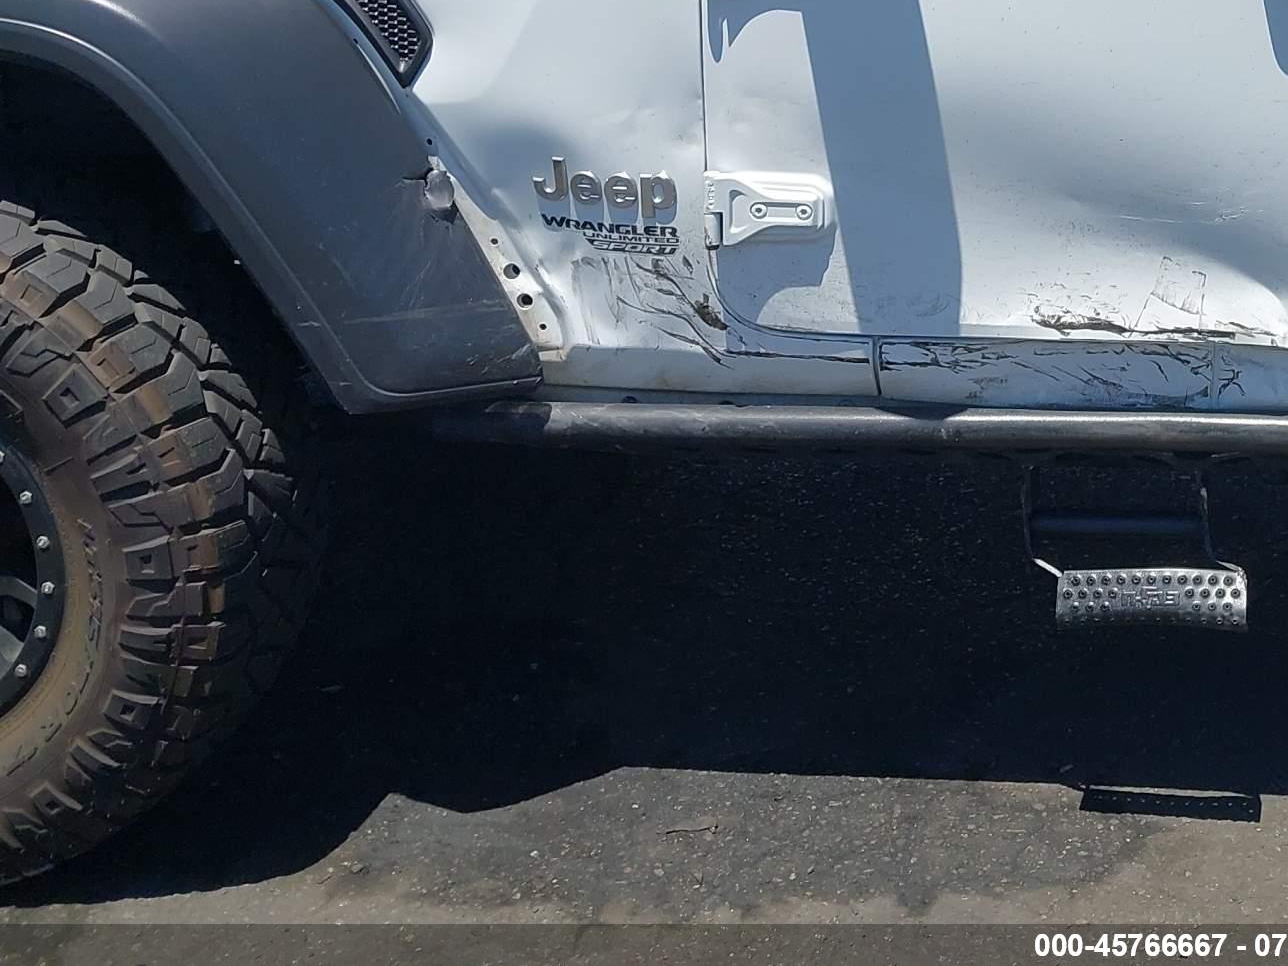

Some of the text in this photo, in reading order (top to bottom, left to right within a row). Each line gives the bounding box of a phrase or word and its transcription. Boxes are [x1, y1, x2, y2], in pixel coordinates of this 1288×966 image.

[532, 156, 678, 219] Jeep
[541, 213, 680, 238] WRANGLER
[583, 232, 680, 244] UNLIMITED
[591, 241, 679, 255] SPORT
